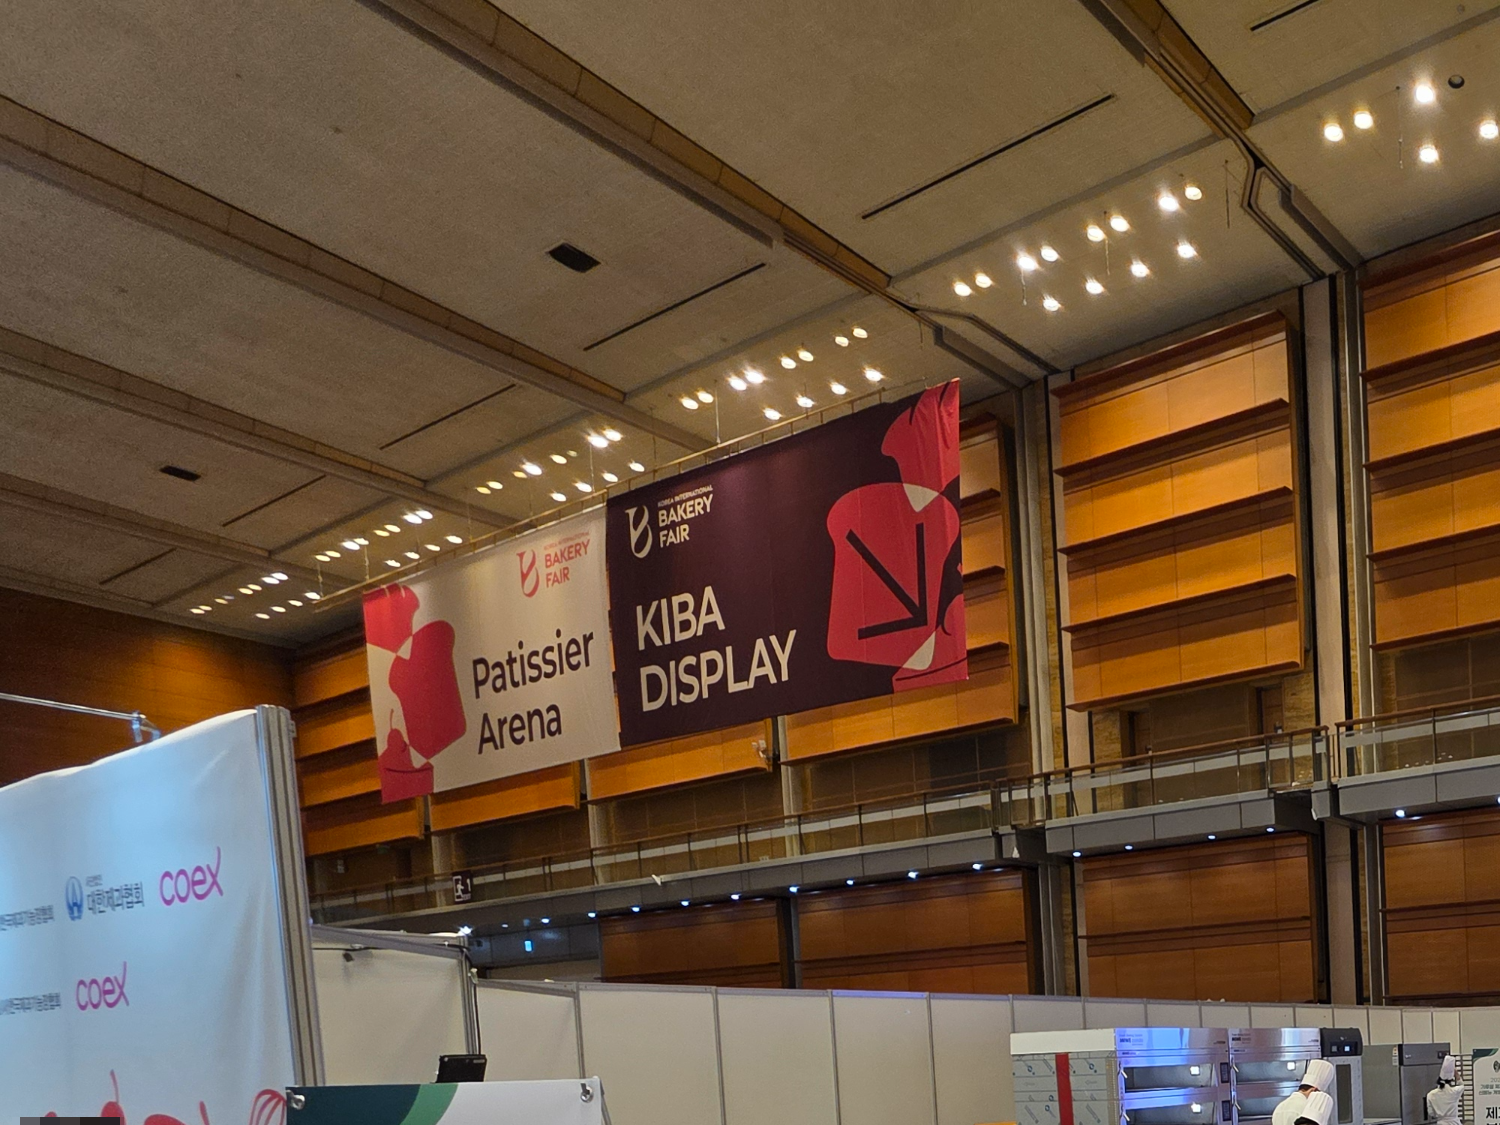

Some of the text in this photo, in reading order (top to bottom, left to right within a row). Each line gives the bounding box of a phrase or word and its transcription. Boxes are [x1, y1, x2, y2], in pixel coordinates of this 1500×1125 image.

[658, 494, 714, 527] BAKERY
[659, 525, 690, 548] FAIR
[545, 539, 591, 569] BAKERY
[546, 567, 570, 588] FAIR
[636, 586, 725, 651] KIBA
[472, 628, 595, 699] Patissier
[640, 629, 797, 713] DISPLAY
[478, 702, 563, 756] Arena
[159, 846, 224, 906] coex
[76, 961, 129, 1011] coex
